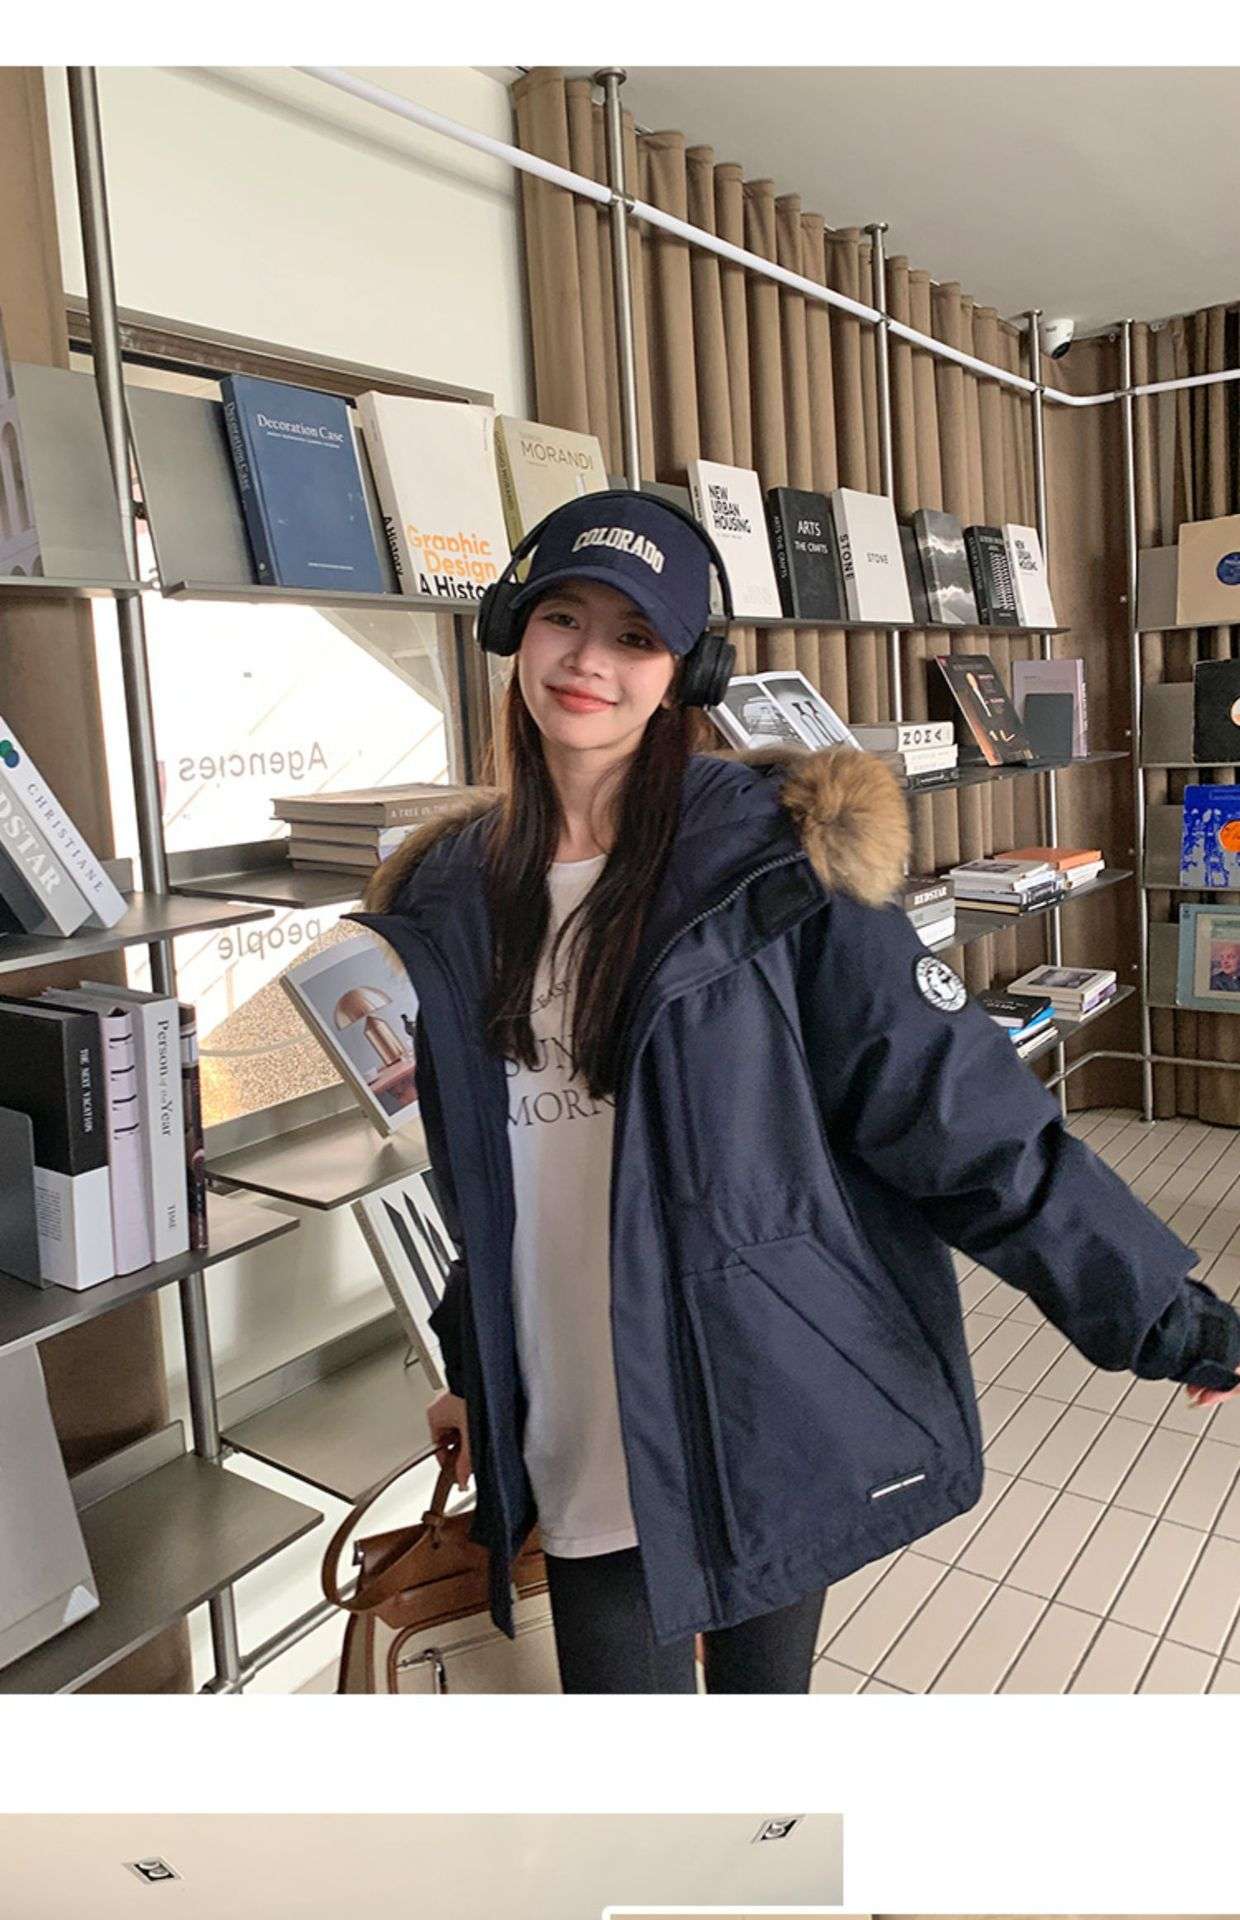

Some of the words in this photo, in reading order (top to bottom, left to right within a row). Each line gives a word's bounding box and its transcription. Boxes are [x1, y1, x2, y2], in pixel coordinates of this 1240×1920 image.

[256, 413, 318, 437] Decoration
[319, 427, 344, 443] Case
[520, 440, 593, 470] MORANDI
[708, 484, 728, 500] NEW
[711, 500, 741, 516] URBAN
[713, 515, 751, 533] HOUSING
[797, 519, 822, 536] ARTS
[406, 524, 493, 556] Graphic
[571, 526, 666, 574] COLORADO
[423, 548, 497, 584] Design
[840, 534, 856, 578] STONE
[419, 573, 432, 595] A
[27, 783, 103, 893] CHRISTIANE
[158, 1020, 169, 1076] Person
[161, 1101, 173, 1136] Year
